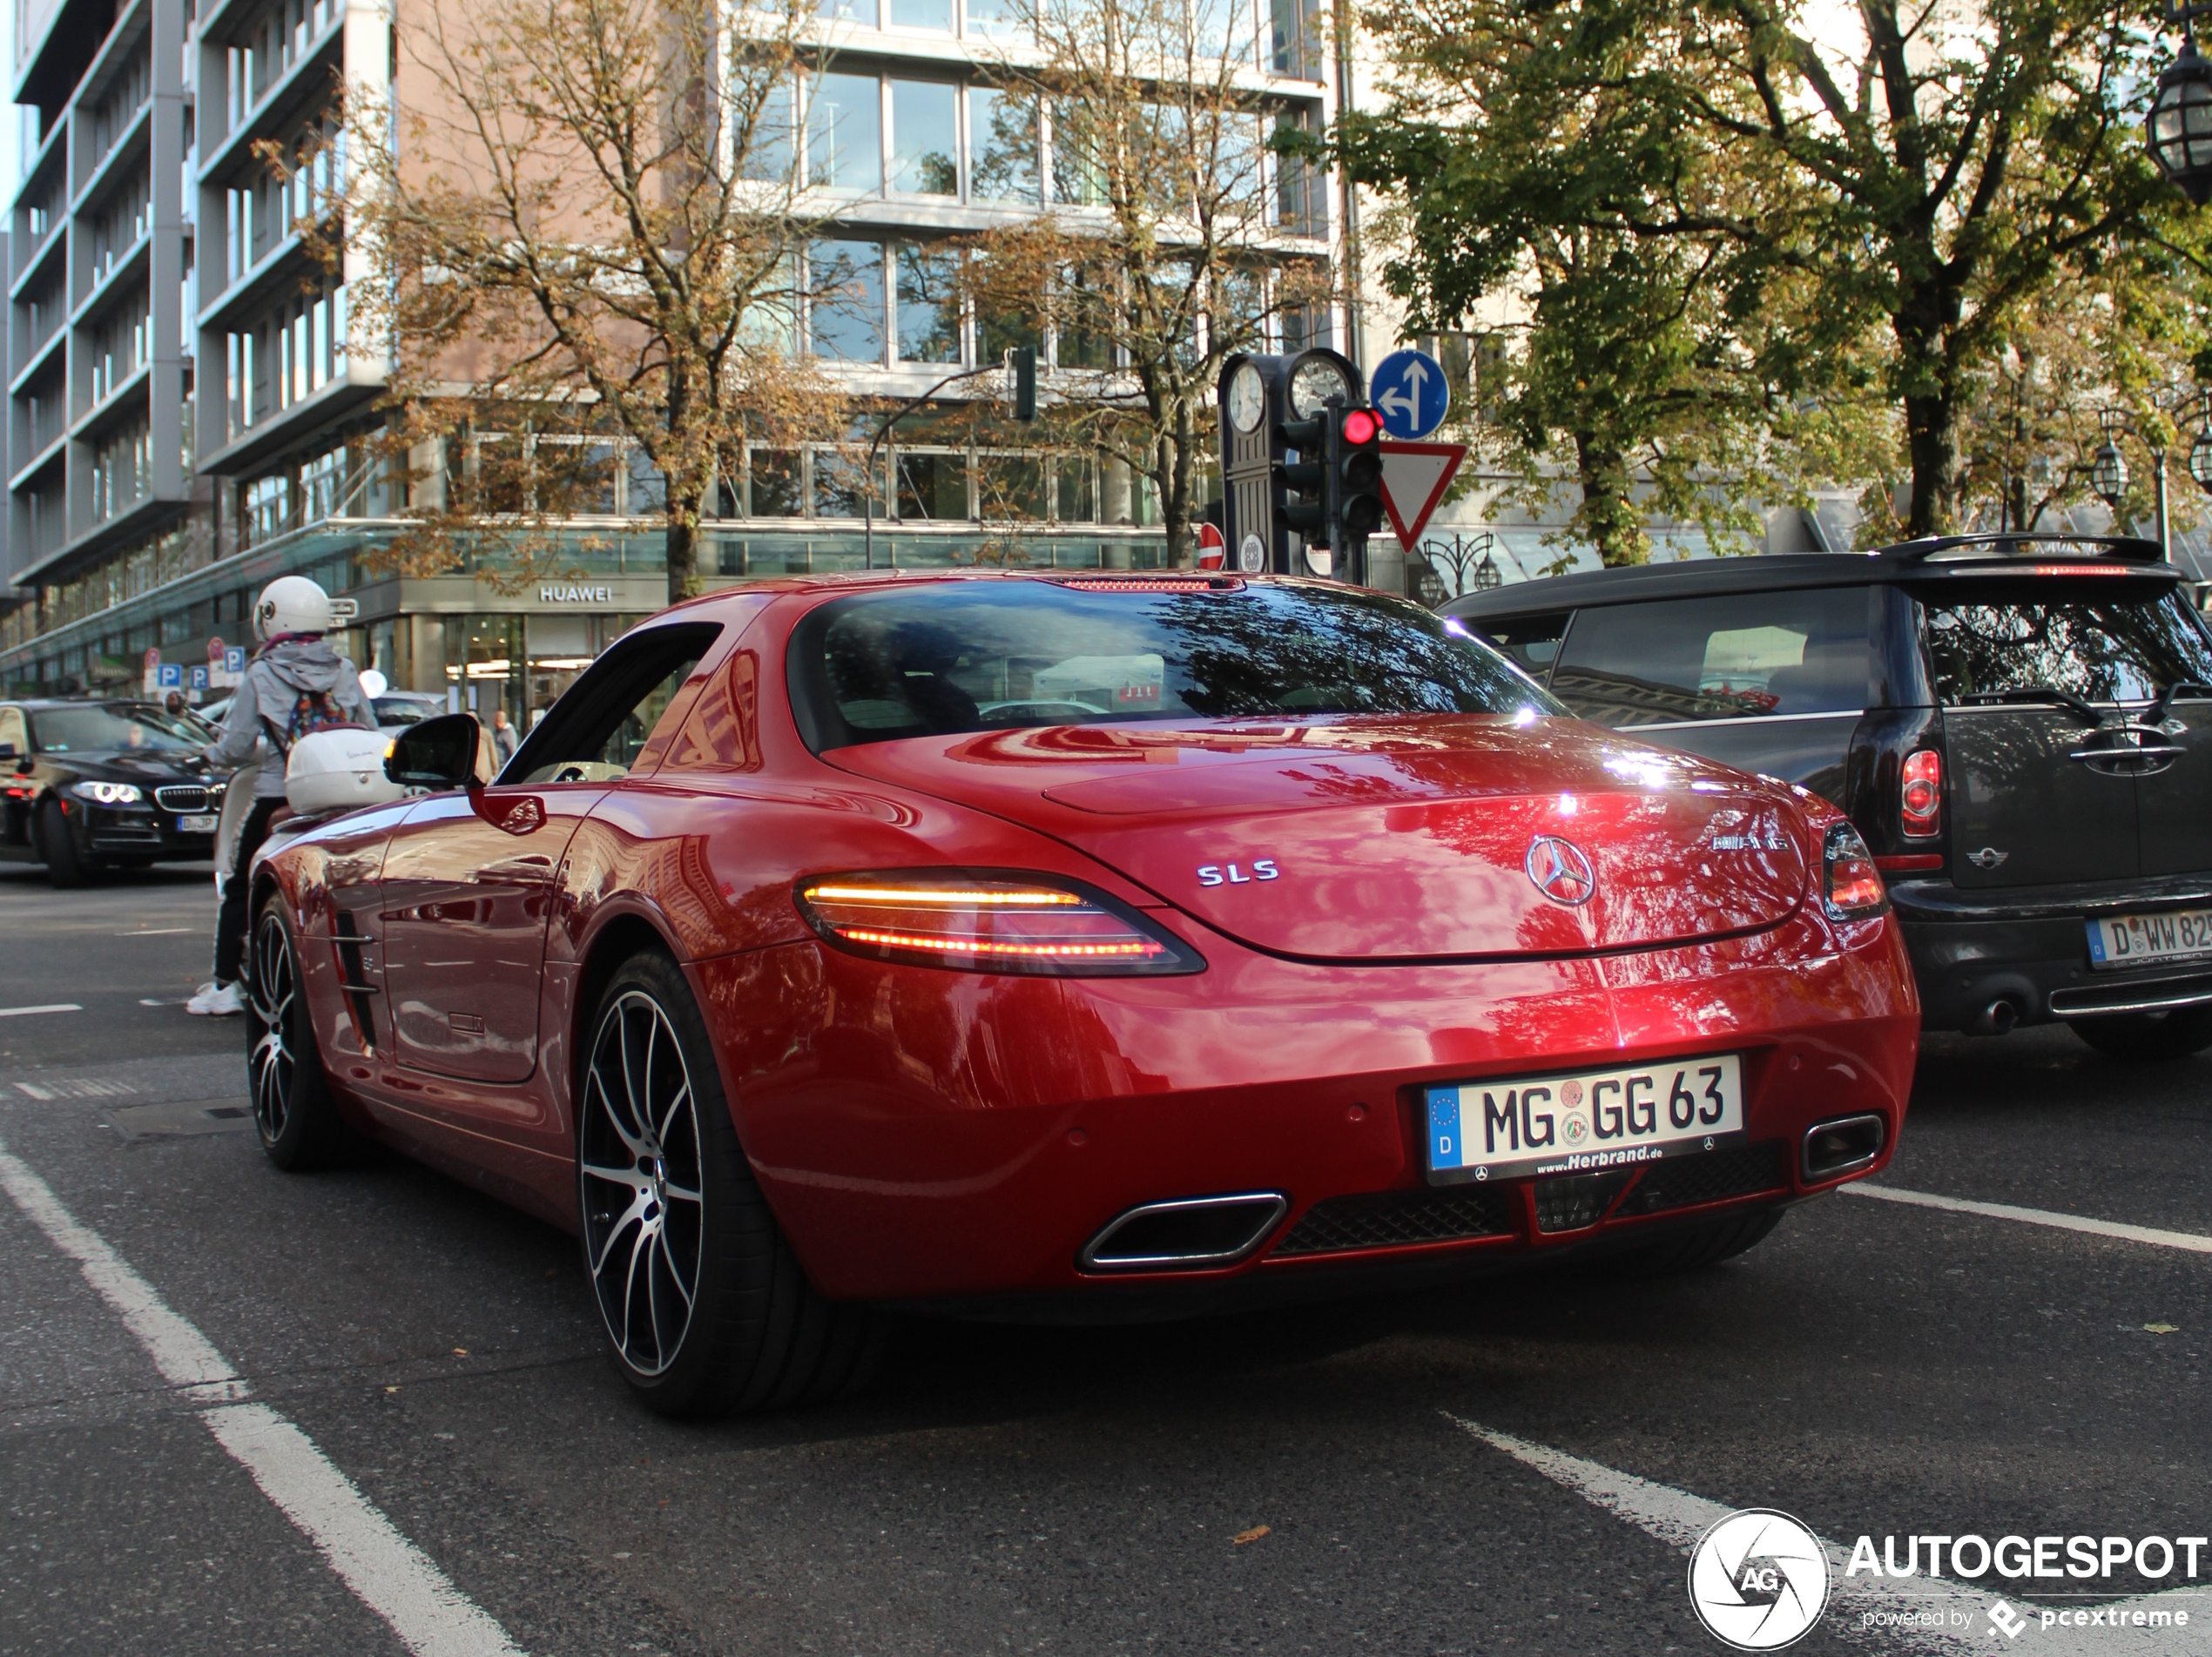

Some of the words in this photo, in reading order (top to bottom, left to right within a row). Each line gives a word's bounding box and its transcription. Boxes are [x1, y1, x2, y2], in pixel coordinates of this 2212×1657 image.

[540, 586, 611, 602] HUAWEI
[228, 650, 241, 671] P
[162, 667, 179, 686] P
[193, 669, 206, 688] P
[1197, 859, 1278, 886] SLS
[2110, 921, 2130, 956] D
[2143, 916, 2176, 952] WW
[2094, 945, 2101, 955] D
[1483, 1086, 1555, 1154] MG
[1592, 1072, 1656, 1140] GG
[1669, 1065, 1724, 1129] 63
[1440, 1136, 1452, 1155] D
[1536, 1145, 1663, 1175] www.Herbrand.de
